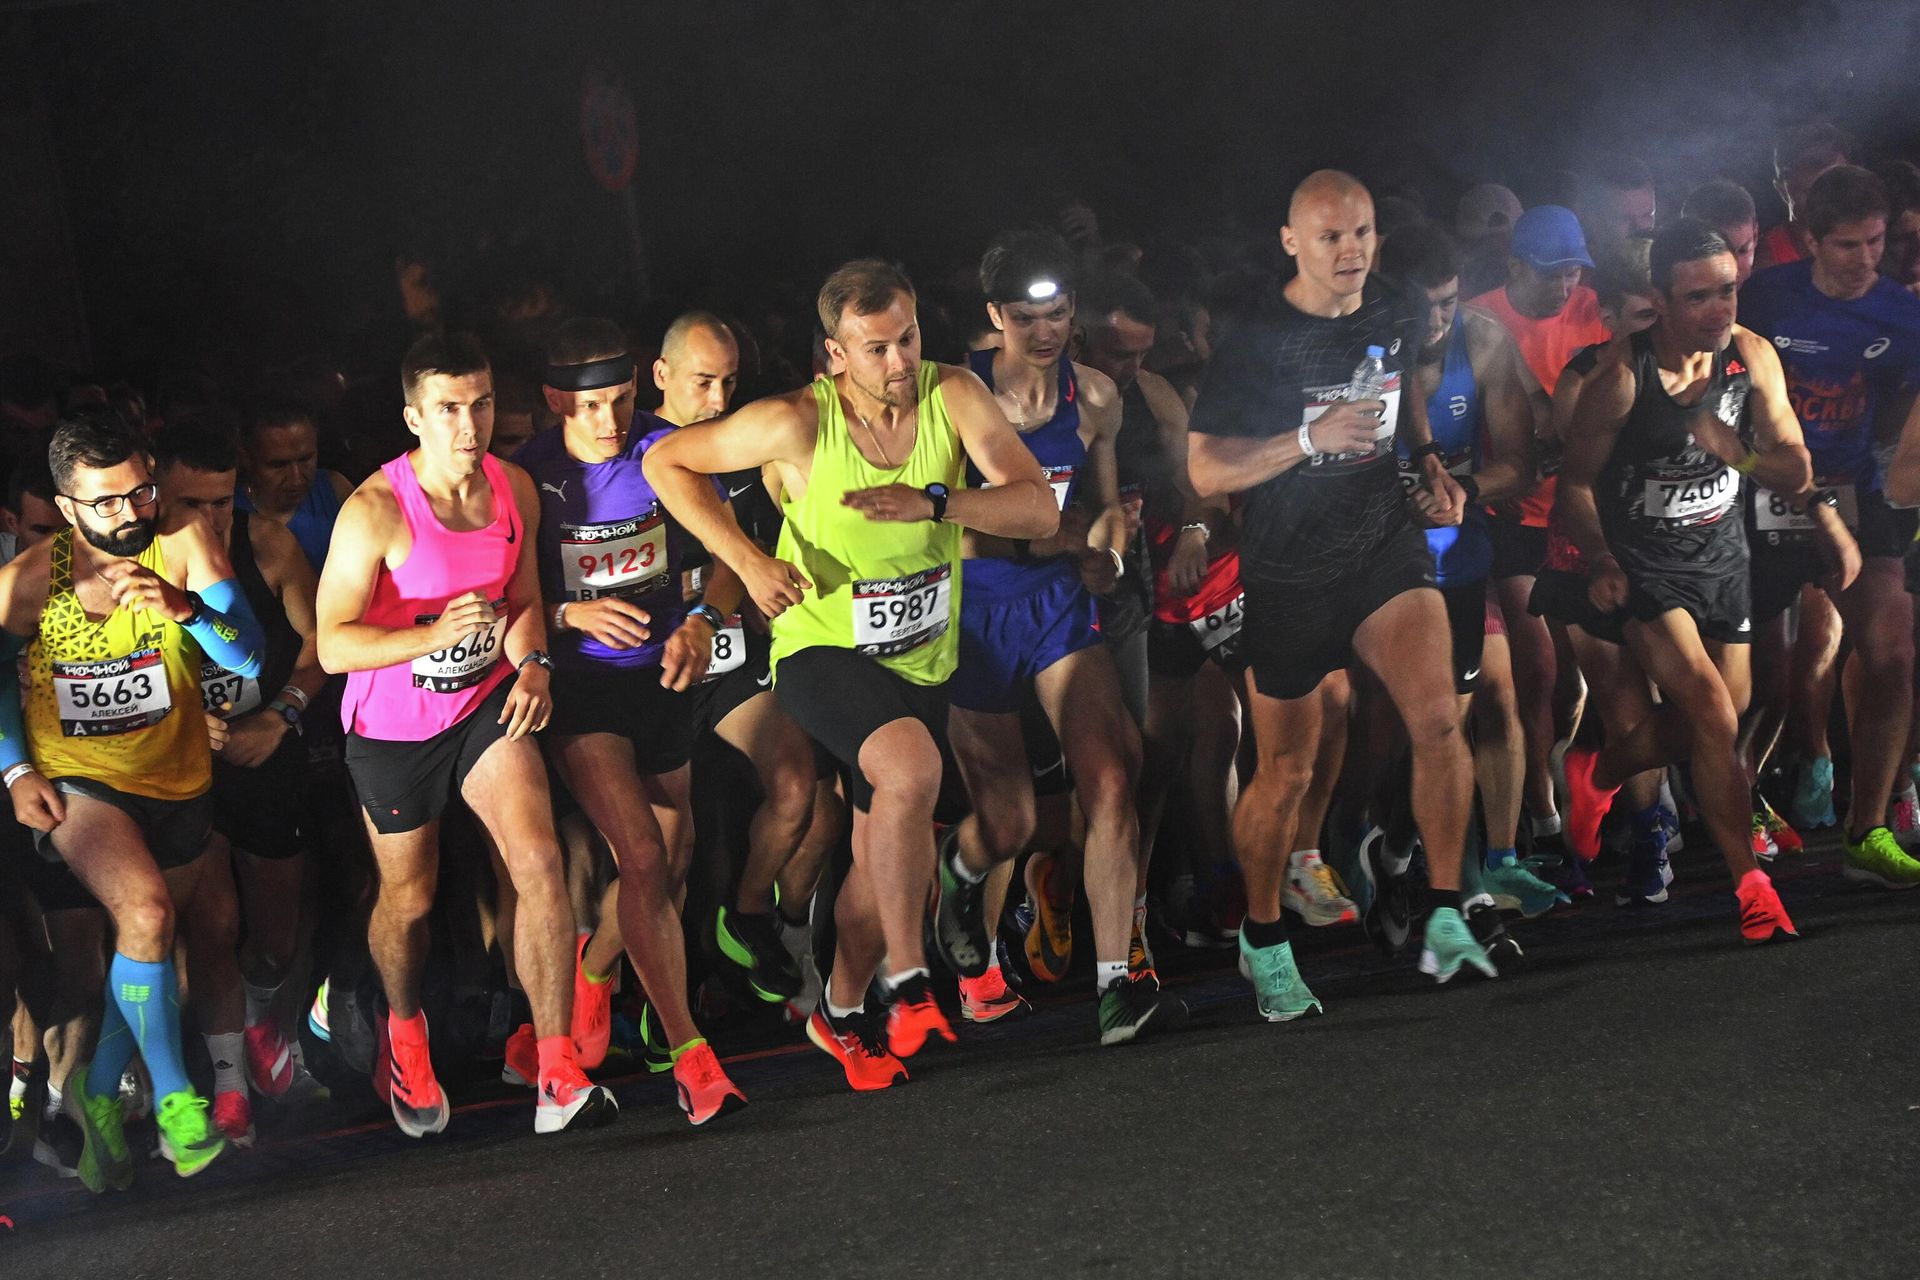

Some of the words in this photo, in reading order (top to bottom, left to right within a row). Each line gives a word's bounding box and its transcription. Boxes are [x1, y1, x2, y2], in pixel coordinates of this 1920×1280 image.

[1659, 470, 1730, 506] 7400
[577, 542, 656, 578] 9123
[869, 586, 938, 629] 5987
[437, 656, 489, 675] АЛЕКСАНДР
[69, 673, 152, 709] 5663
[91, 703, 139, 719] АЛЕКСЕЙ
